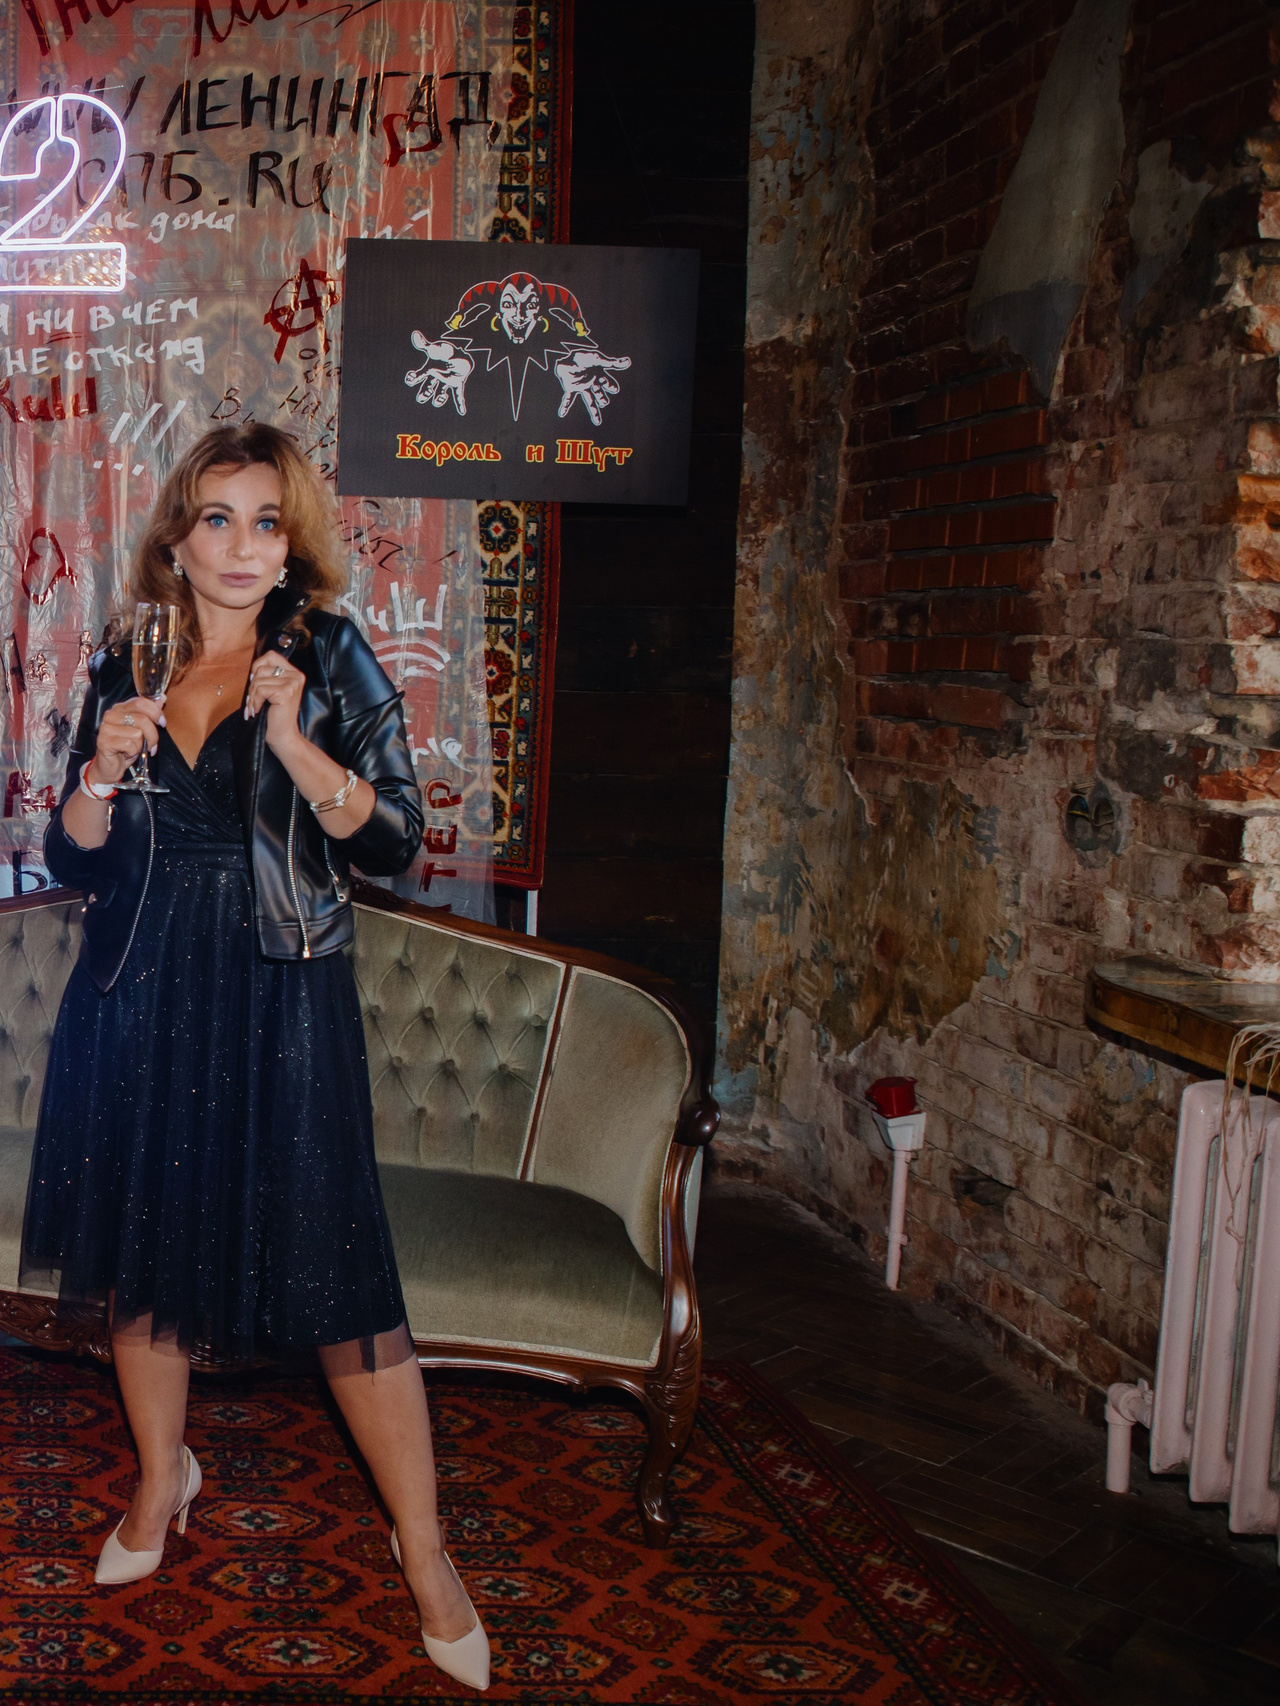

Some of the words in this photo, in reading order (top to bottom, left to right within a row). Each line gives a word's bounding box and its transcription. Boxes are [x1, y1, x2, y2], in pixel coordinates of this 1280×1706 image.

[396, 434, 502, 467] Король
[525, 444, 544, 463] и
[555, 438, 634, 473] Шут
